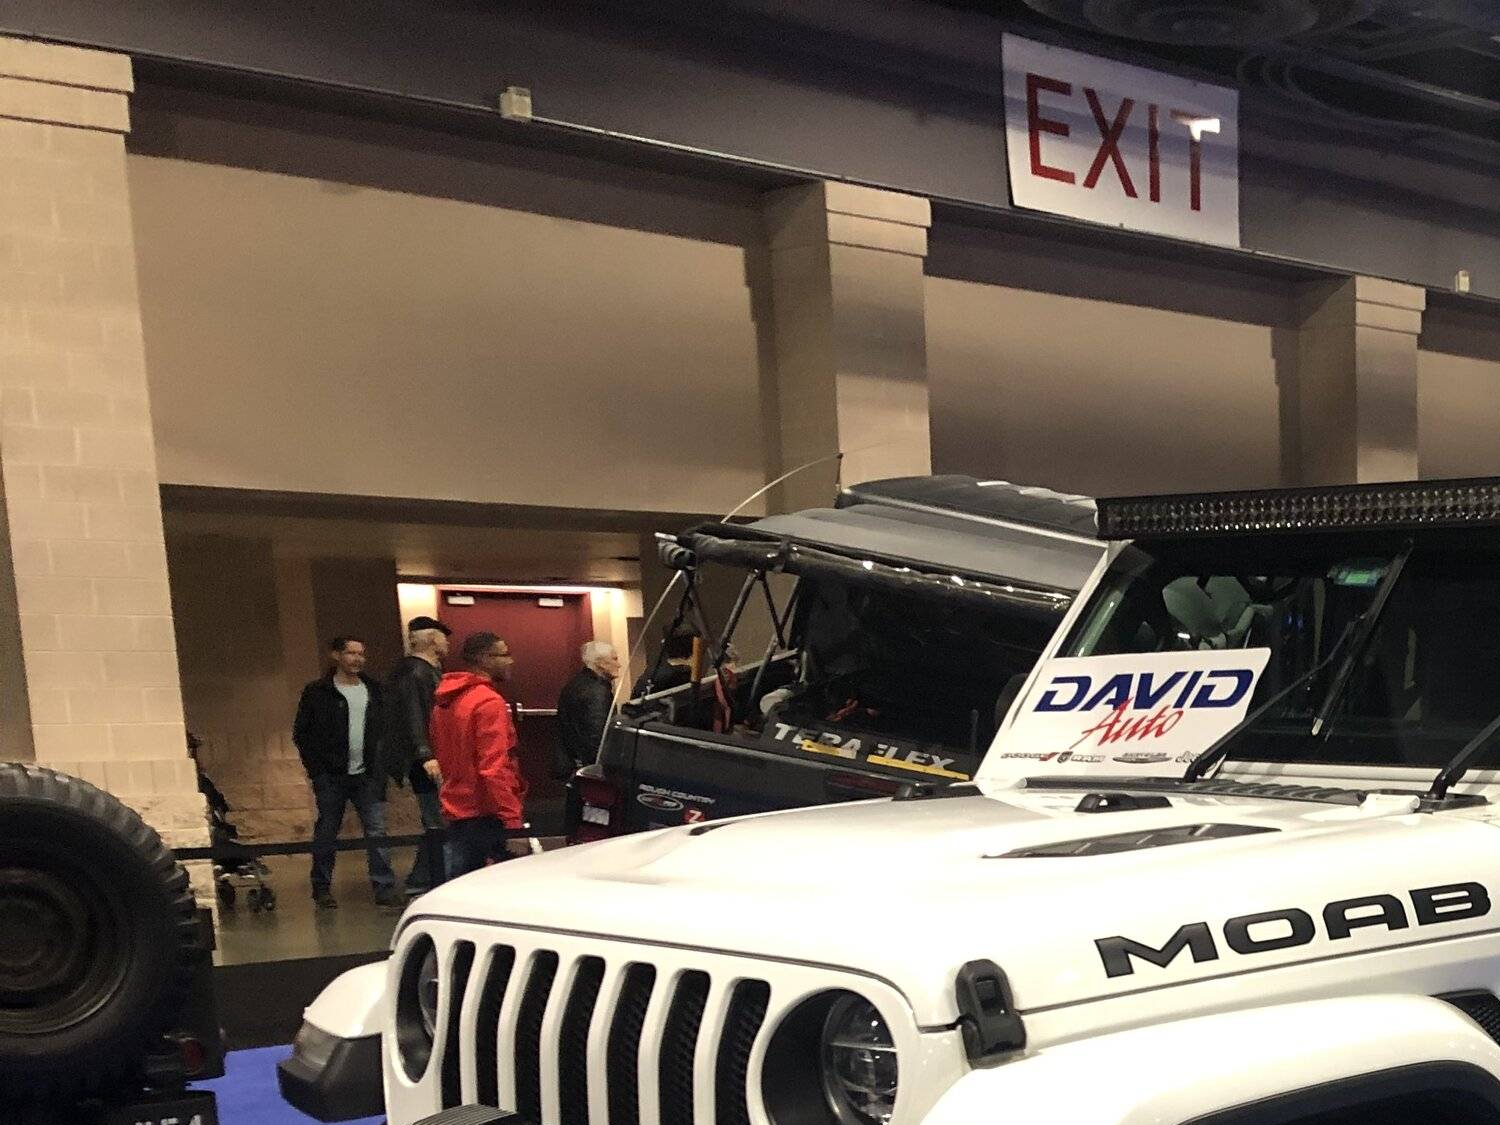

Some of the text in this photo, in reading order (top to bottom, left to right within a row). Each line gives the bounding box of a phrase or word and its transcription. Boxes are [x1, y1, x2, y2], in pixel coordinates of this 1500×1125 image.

[1026, 72, 1221, 211] EXIT
[1033, 669, 1255, 713] DAVID
[1069, 697, 1184, 750] Auto
[1094, 881, 1492, 979] MOAB
